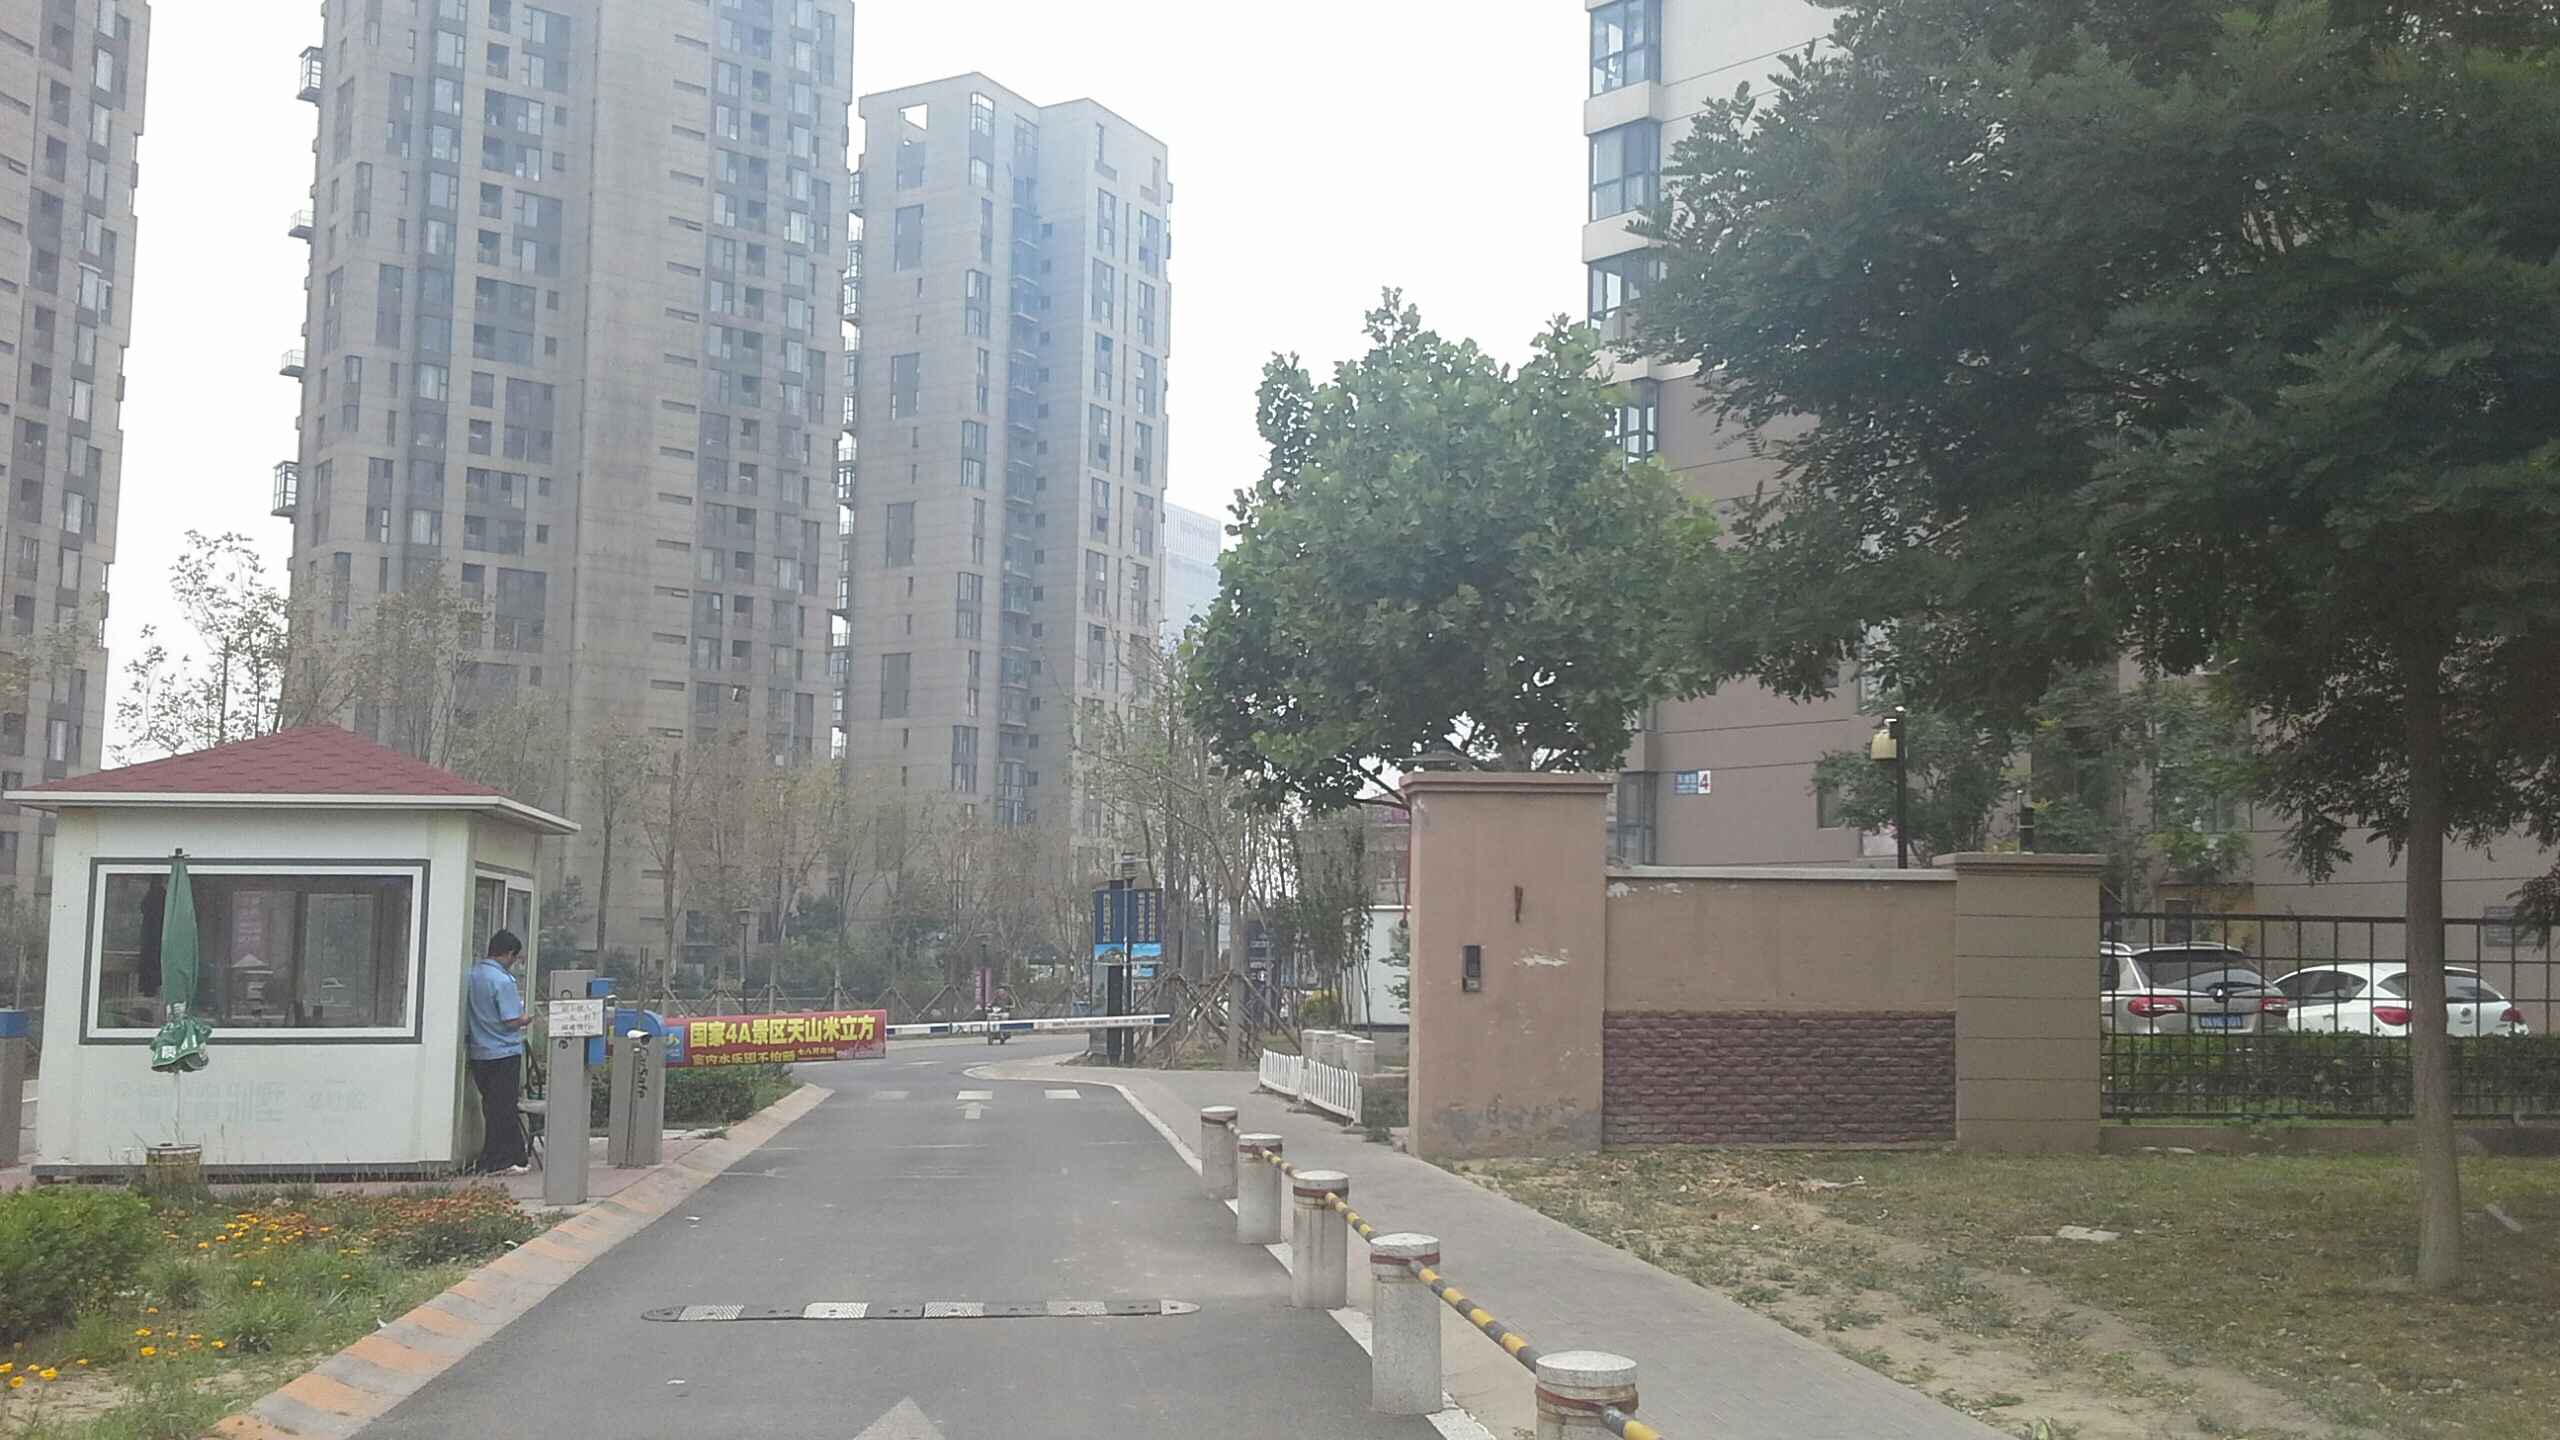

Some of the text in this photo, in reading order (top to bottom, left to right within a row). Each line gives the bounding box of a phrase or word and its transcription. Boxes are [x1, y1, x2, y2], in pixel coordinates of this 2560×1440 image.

[1699, 773, 1709, 790] 4
[689, 1015, 875, 1048] 国家4A景区天山米立方
